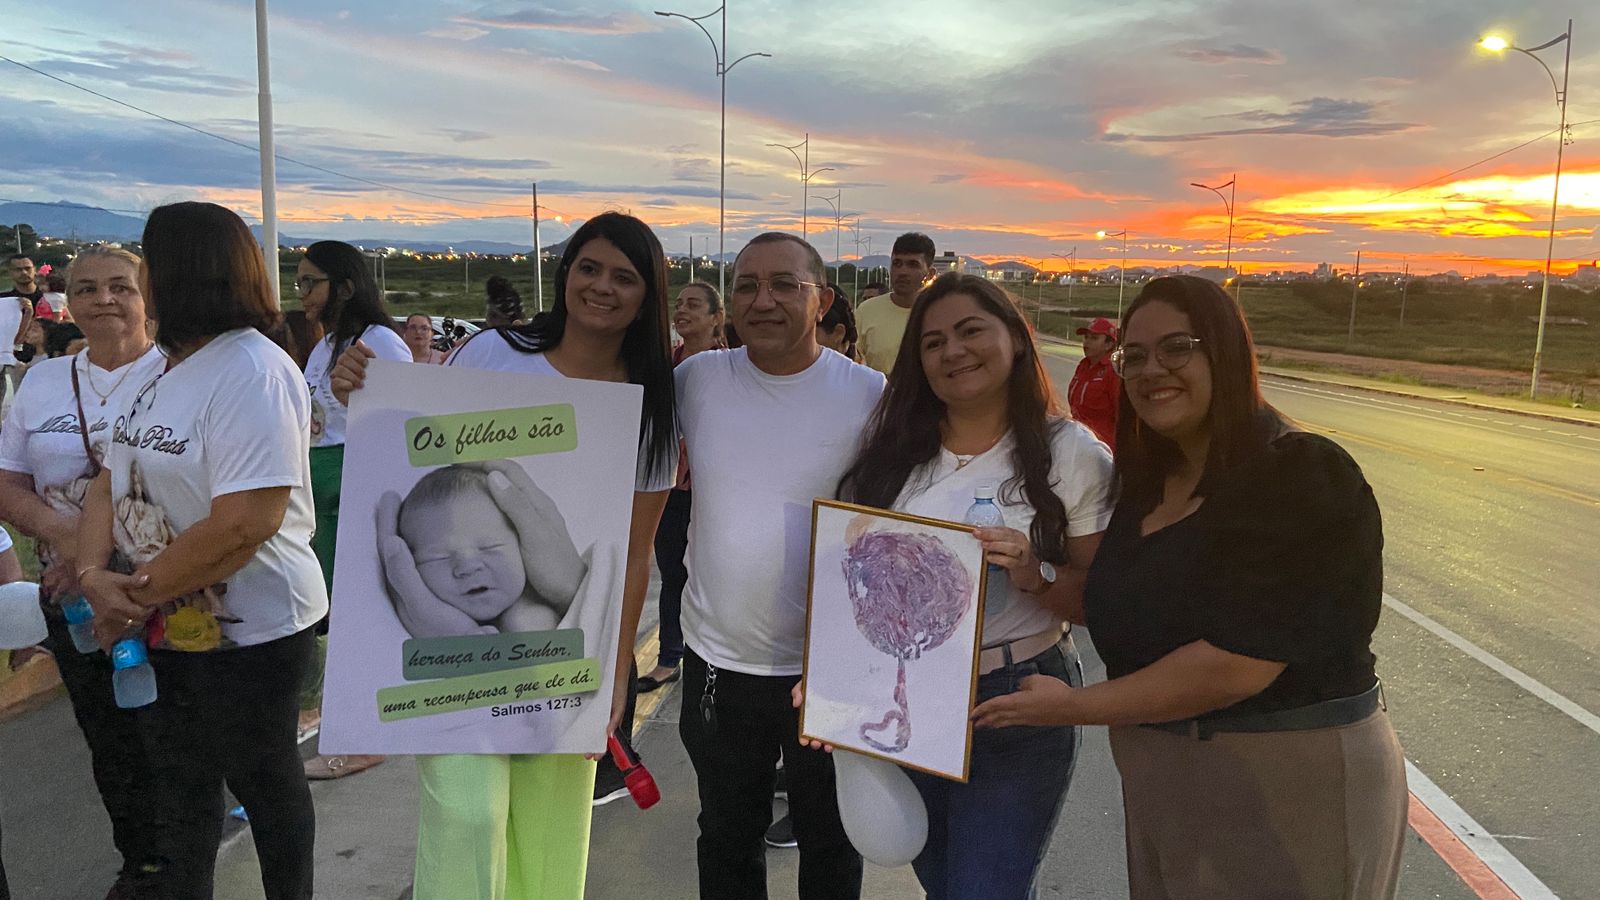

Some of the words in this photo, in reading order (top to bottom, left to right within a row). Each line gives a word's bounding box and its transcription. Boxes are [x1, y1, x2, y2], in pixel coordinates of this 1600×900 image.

[413, 426, 447, 450] Os
[455, 419, 518, 455] filhos
[527, 416, 565, 439] são
[408, 650, 474, 668] herança
[481, 648, 501, 662] do
[508, 641, 572, 661] Senhor.
[383, 700, 416, 713] uma
[423, 686, 508, 708] recompensa
[514, 681, 540, 698] que
[545, 673, 565, 688] ele
[570, 668, 594, 684] dá.
[491, 702, 542, 717] Salmos
[548, 697, 582, 710] 127:3
